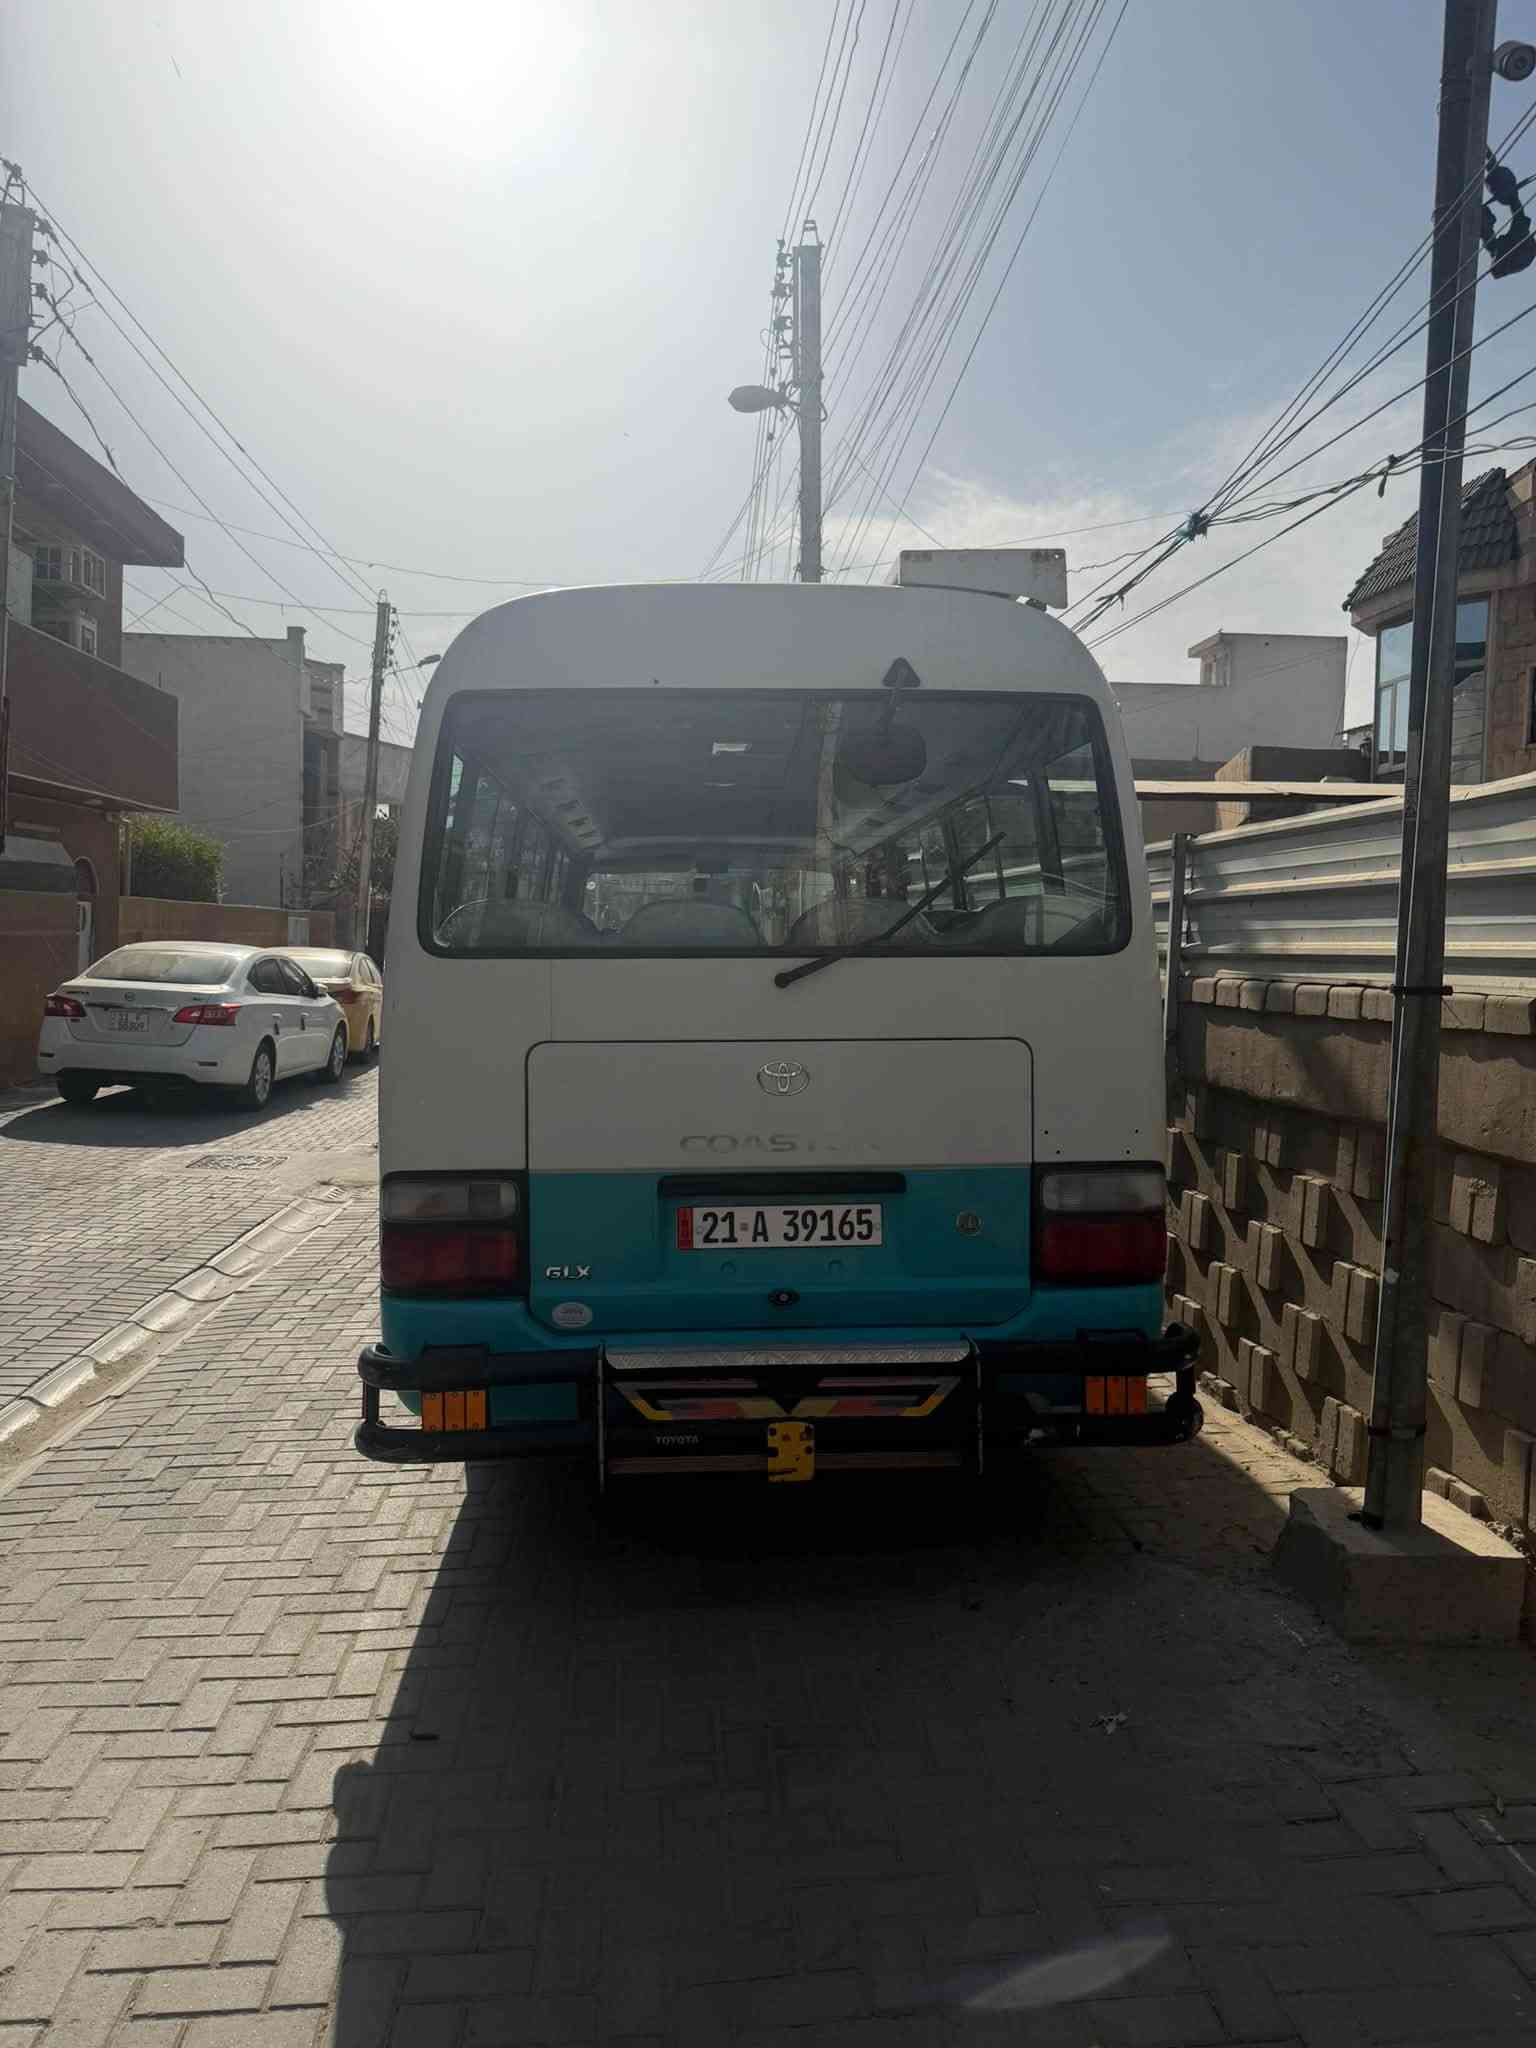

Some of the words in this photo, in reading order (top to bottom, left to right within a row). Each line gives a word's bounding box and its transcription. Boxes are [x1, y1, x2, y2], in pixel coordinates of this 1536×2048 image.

[702, 1211, 738, 1244] 21
[752, 1210, 769, 1242] A
[782, 1208, 873, 1242] 39165
[545, 1264, 592, 1279] GLX
[655, 1434, 700, 1446] TOYOTA
